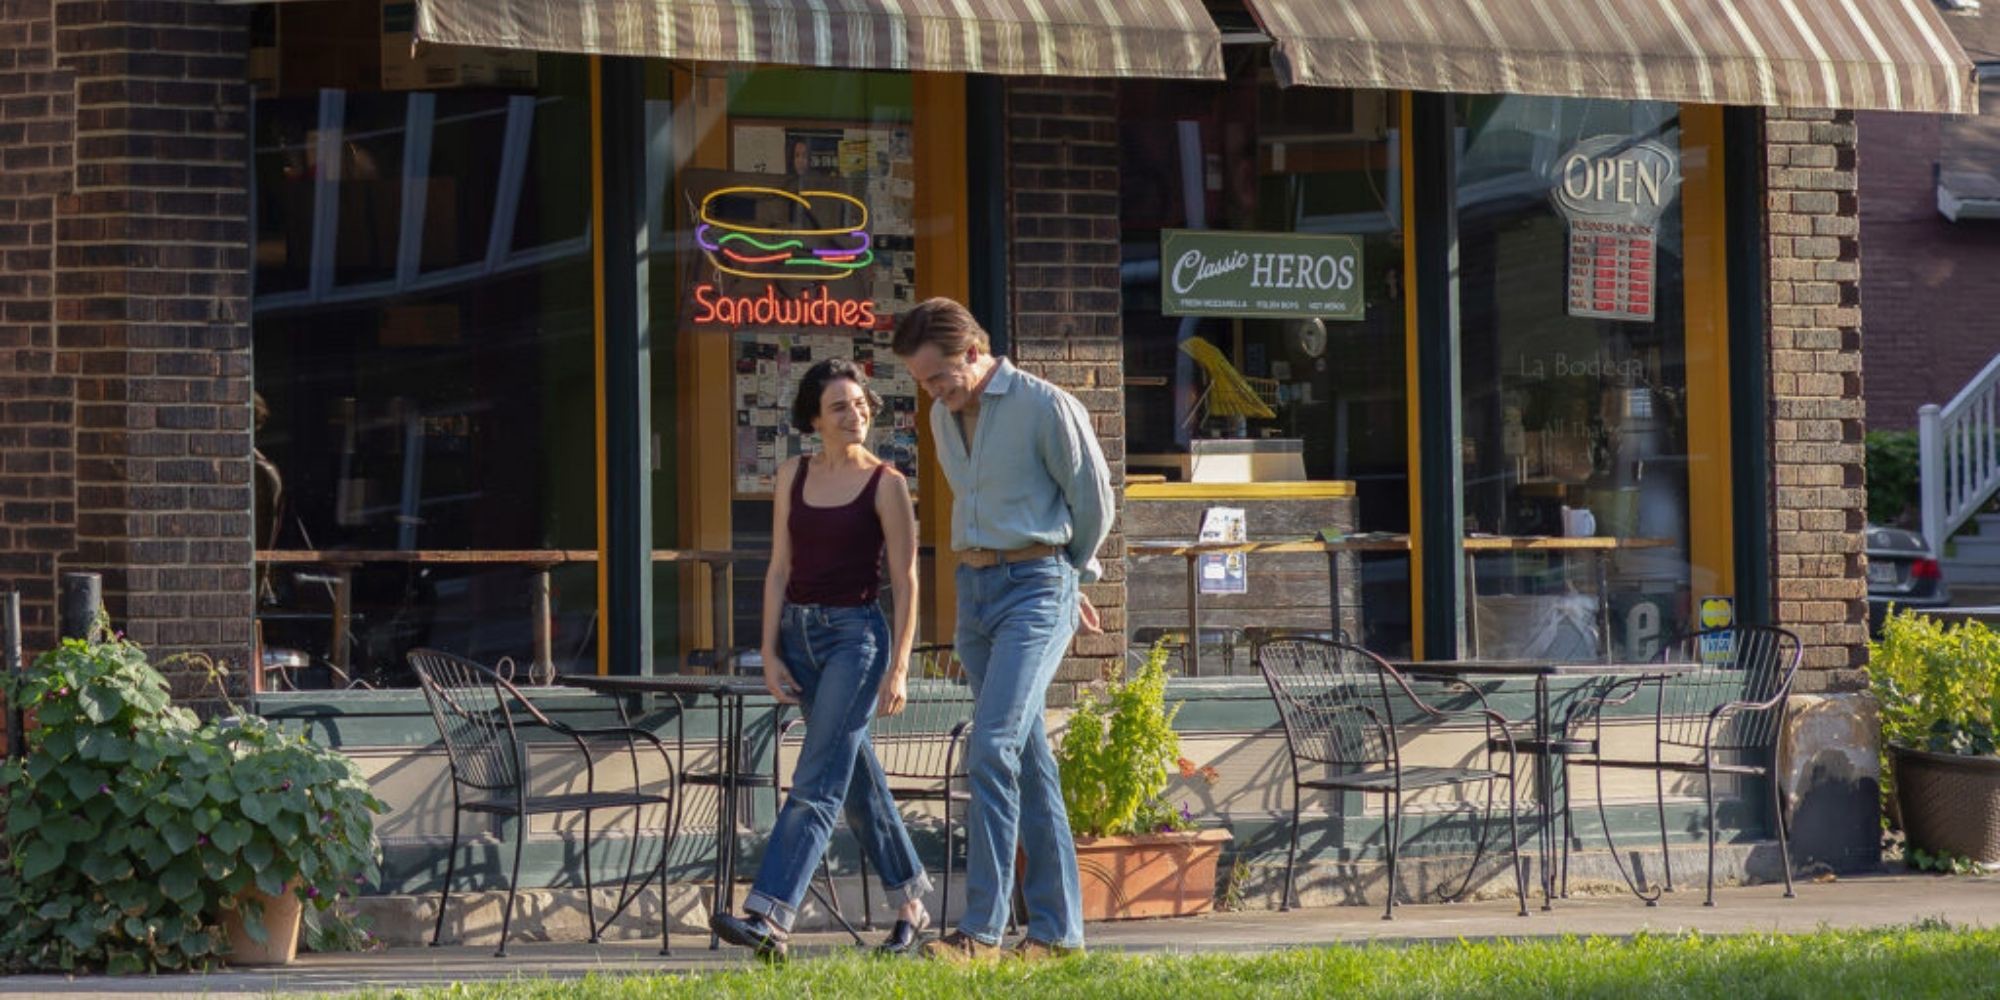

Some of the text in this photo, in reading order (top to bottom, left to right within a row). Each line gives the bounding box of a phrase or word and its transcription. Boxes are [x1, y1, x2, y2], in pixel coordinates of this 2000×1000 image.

[1564, 154, 1661, 206] OPEN
[1171, 249, 1354, 294] Classic HEROS
[695, 284, 876, 328] Sandwiches
[1520, 350, 1643, 384] La Bodega
